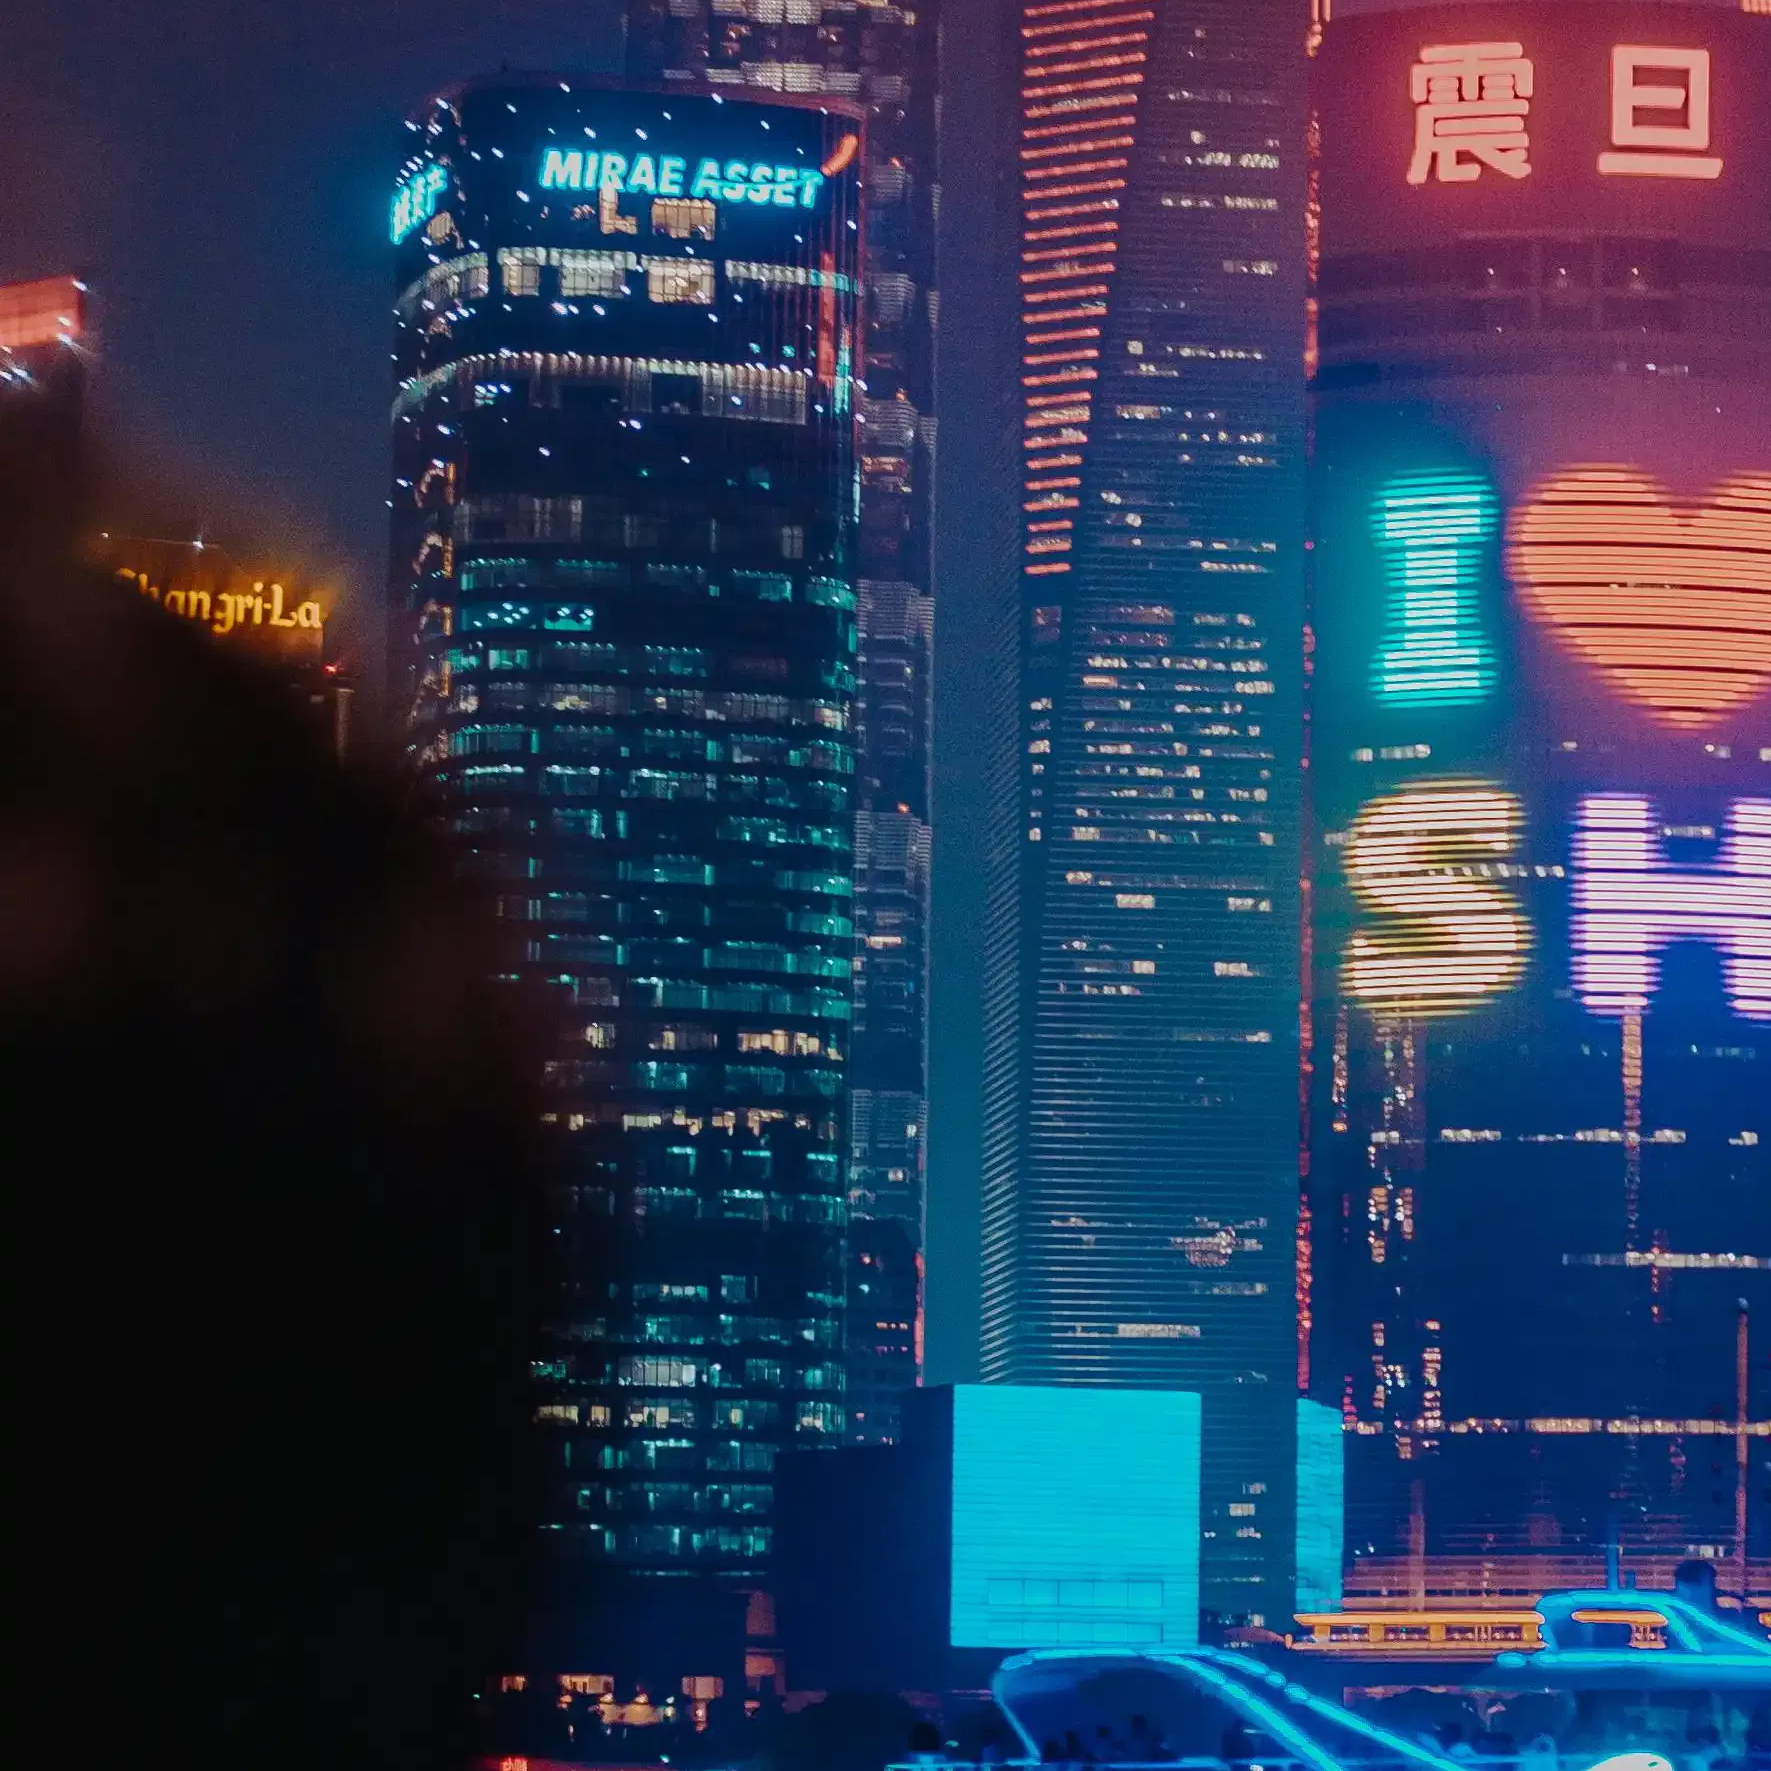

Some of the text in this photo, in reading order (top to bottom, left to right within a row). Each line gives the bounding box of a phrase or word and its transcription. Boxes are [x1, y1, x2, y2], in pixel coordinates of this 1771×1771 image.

[541, 149, 824, 208] MIRAE ASSET
[1407, 42, 1723, 183] 震旦
[1372, 469, 1497, 708] I
